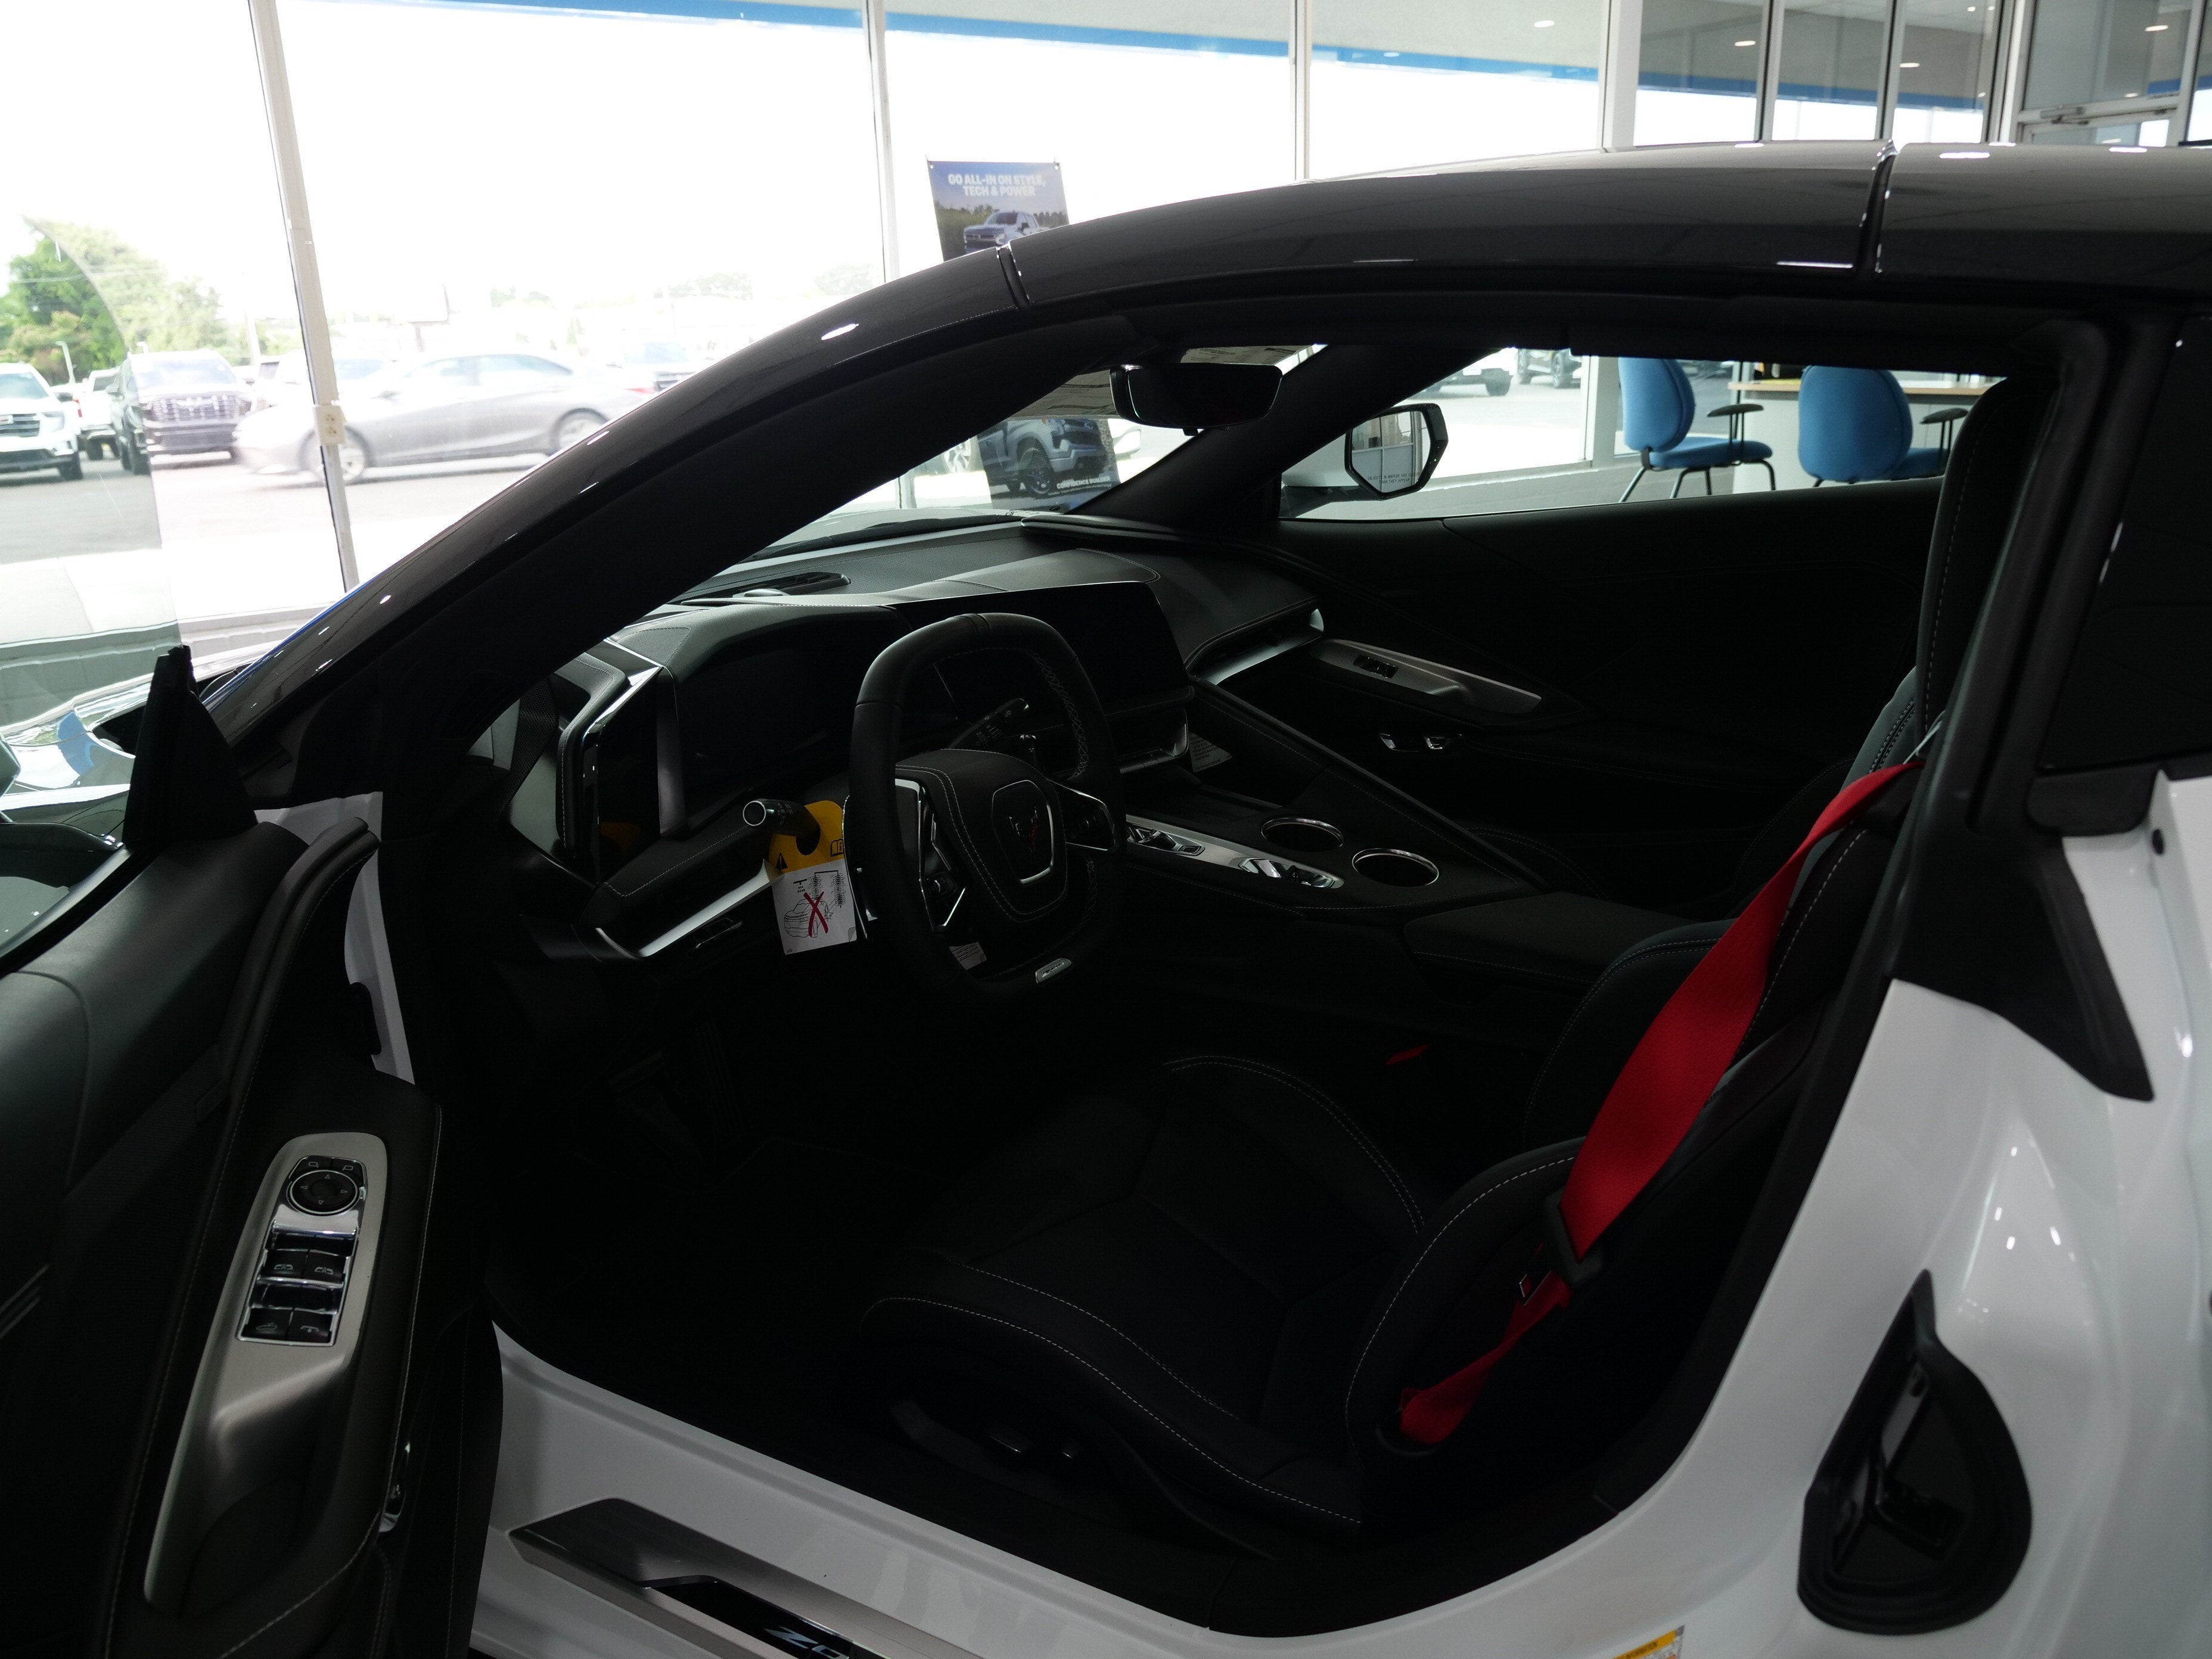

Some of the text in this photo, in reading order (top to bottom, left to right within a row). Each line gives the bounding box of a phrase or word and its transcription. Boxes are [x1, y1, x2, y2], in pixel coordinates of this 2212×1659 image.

[948, 173, 1046, 188] GO ALL-IN ON STYLE,
[962, 186, 1036, 197] TECH & POWER
[1057, 479, 1090, 489] CONFIDENCE
